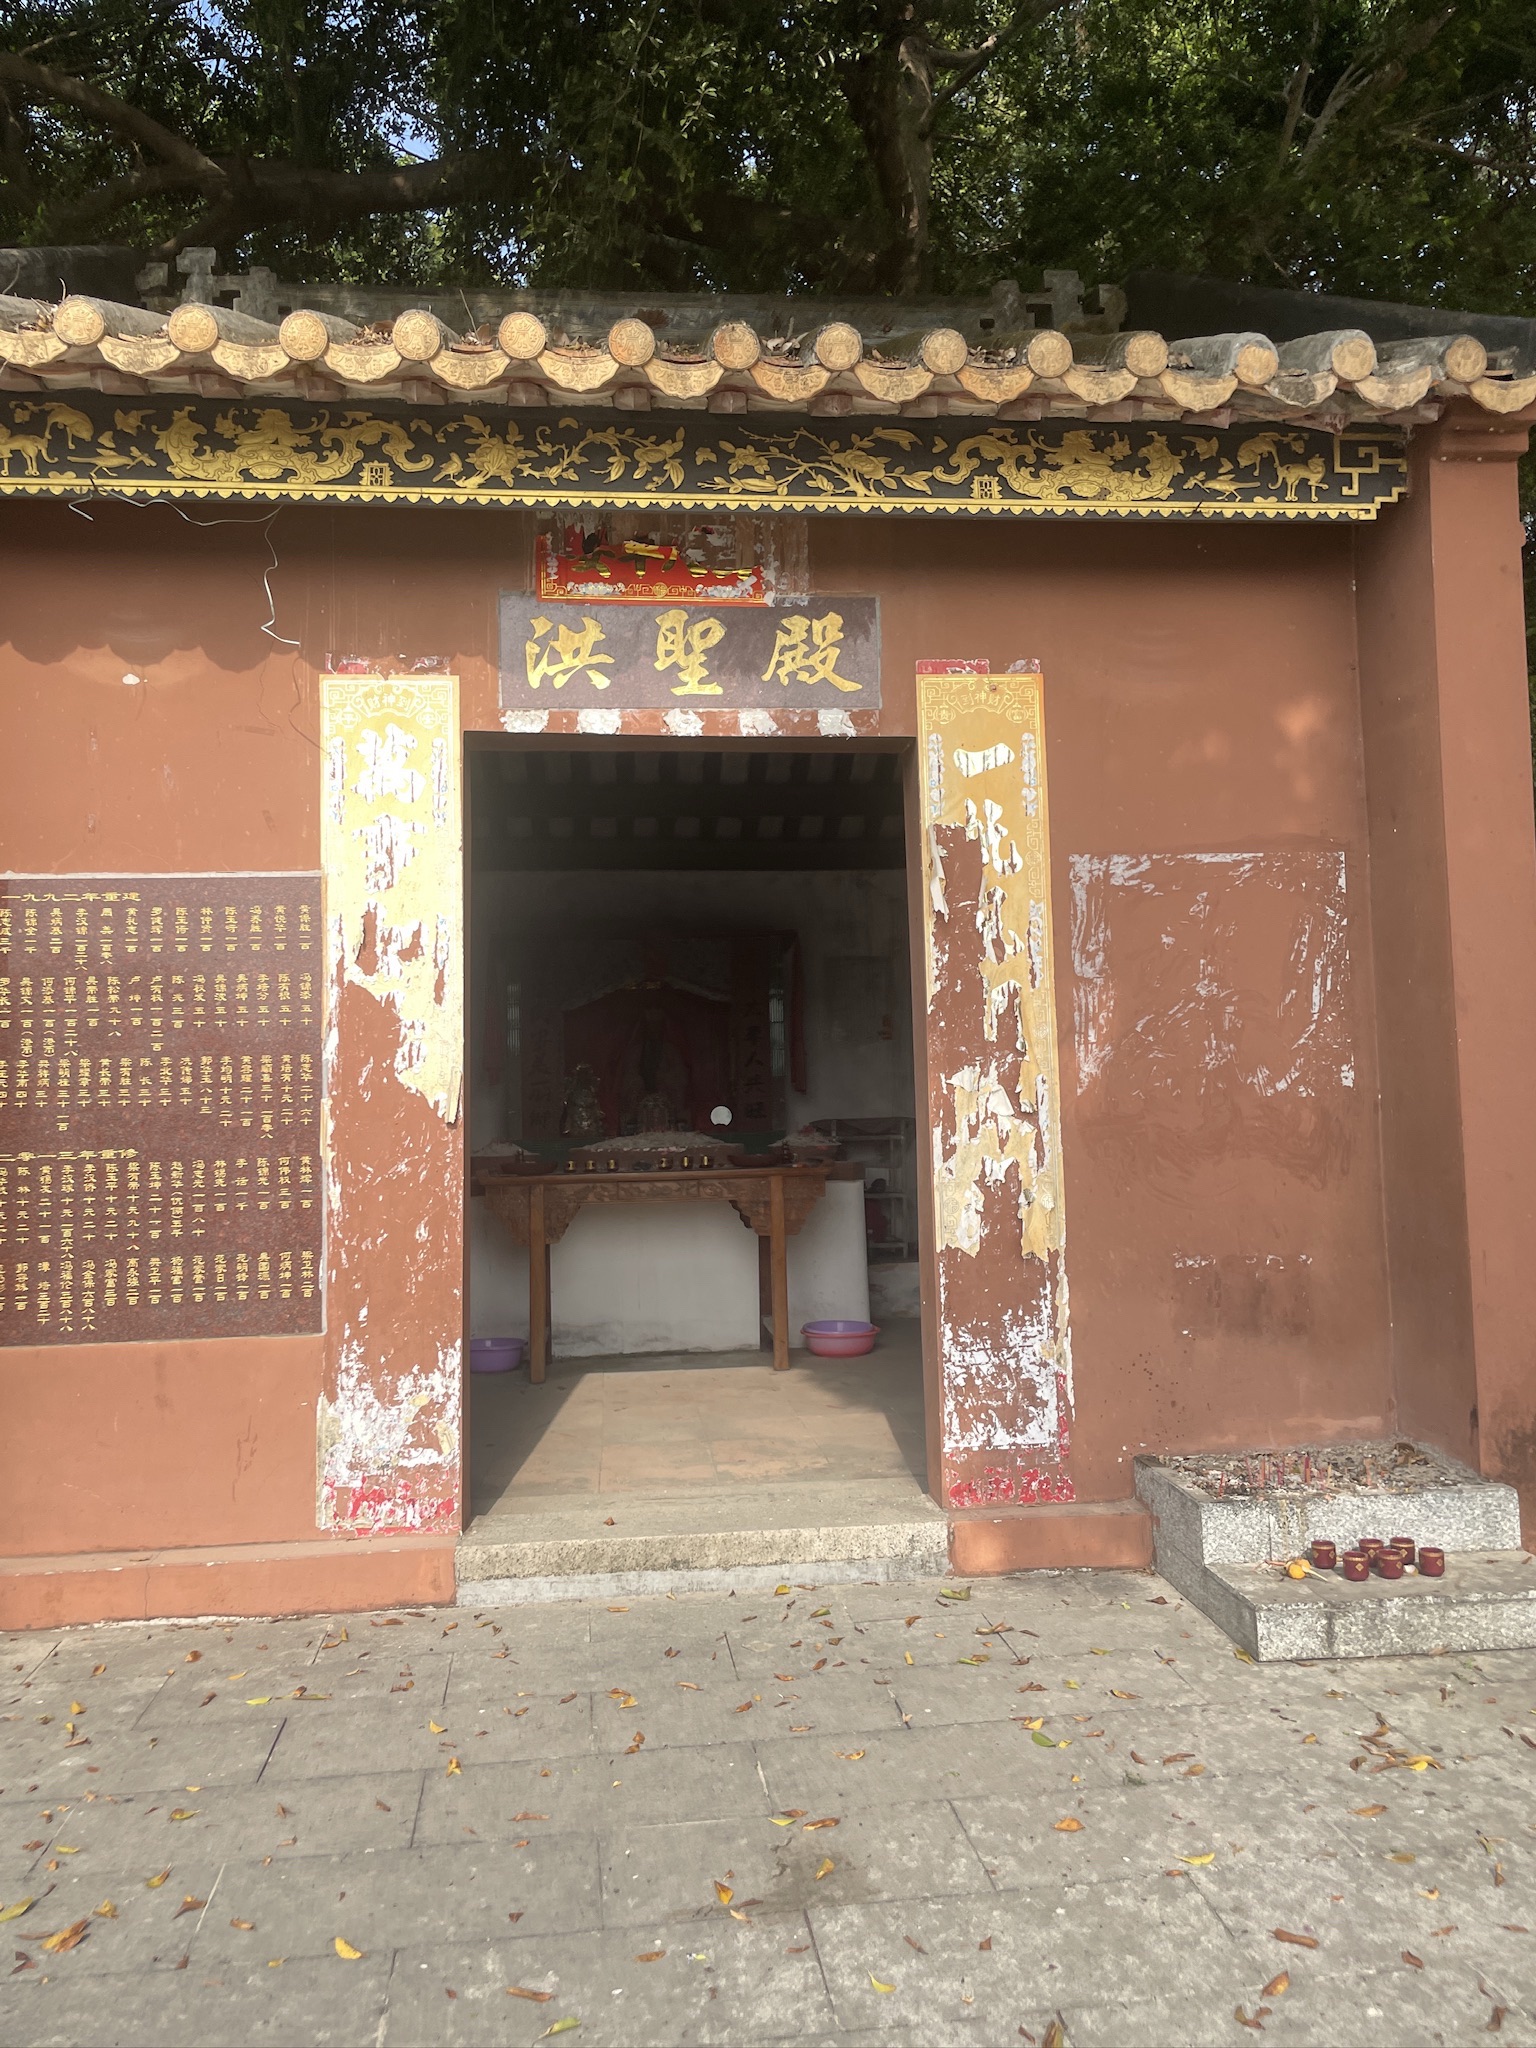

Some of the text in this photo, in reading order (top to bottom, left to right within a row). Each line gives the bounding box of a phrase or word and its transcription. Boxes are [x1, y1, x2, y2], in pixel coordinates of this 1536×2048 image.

[525, 608, 863, 696] 洪聖殿
[1, 892, 142, 902] 一九九二年重建
[0, 1148, 140, 1162] 二零一三年重修
